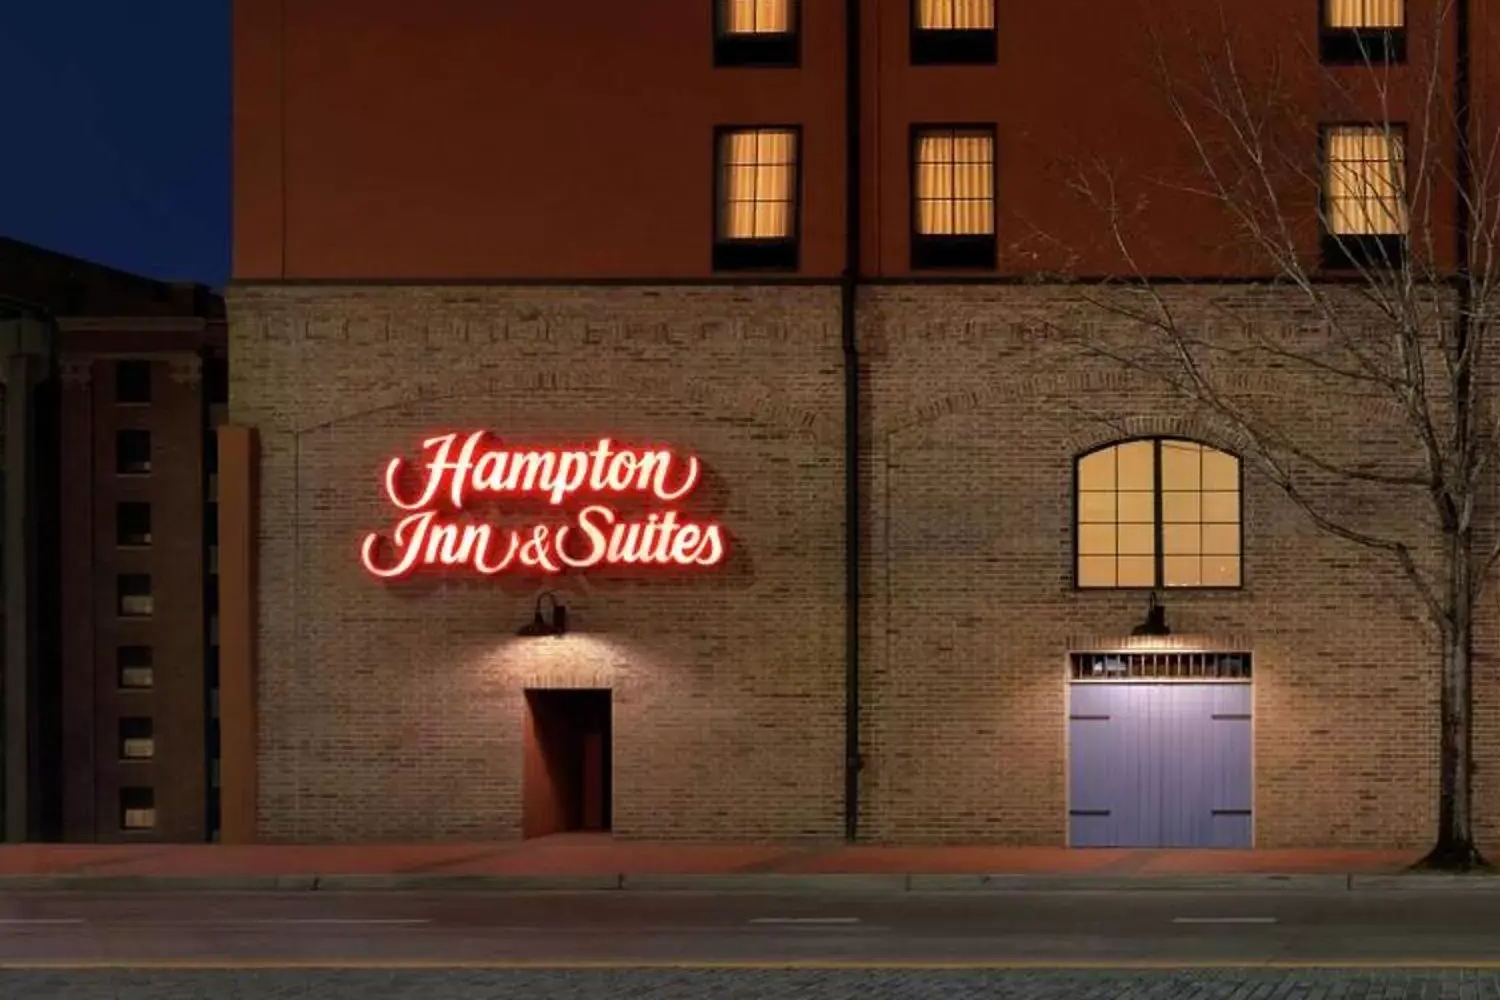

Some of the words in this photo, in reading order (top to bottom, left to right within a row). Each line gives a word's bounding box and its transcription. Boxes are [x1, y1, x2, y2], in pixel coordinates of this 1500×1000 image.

[385, 430, 698, 510] Hampton
[361, 510, 518, 577] Inn
[519, 524, 561, 571] &
[555, 504, 724, 567] Suites
